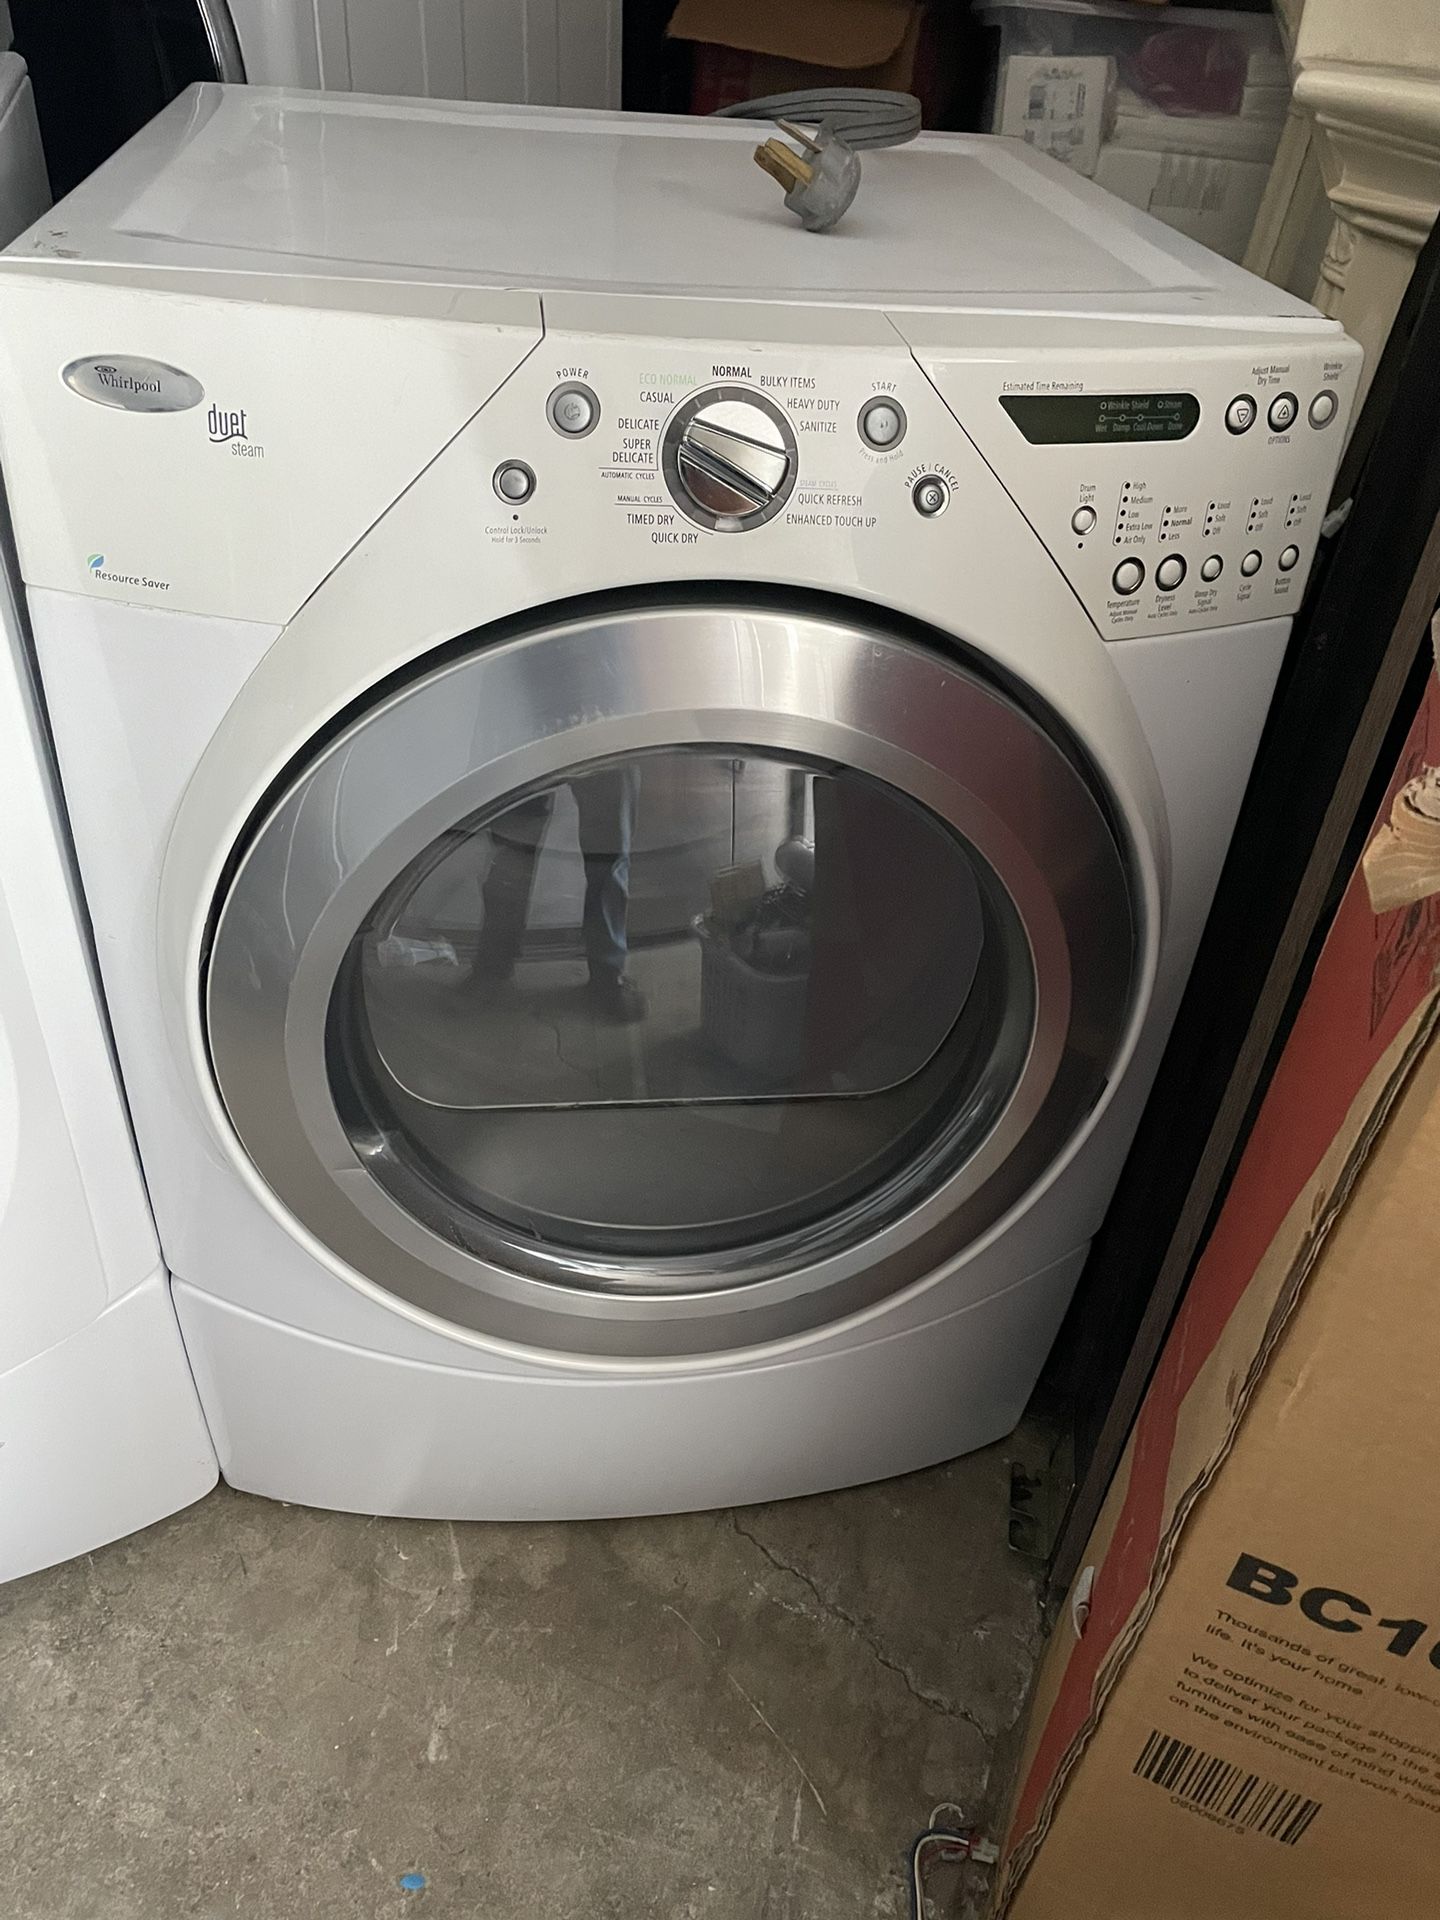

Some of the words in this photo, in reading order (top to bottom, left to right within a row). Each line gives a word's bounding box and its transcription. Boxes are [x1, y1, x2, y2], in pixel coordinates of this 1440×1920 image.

[556, 367, 589, 380] POWER
[712, 366, 752, 378] NORMAL
[1270, 365, 1290, 374] Manual
[98, 373, 161, 394] Whirlpool
[640, 373, 657, 385] ECO
[660, 374, 698, 386] NORMAL
[760, 375, 788, 388] BULKY
[790, 377, 816, 389] ITEMS
[871, 381, 897, 393] START
[1003, 381, 1035, 391] Estimated
[1036, 381, 1050, 390] Time
[1052, 381, 1084, 392] Remaining
[640, 391, 675, 404] CASUAL
[787, 398, 815, 410] HEAVY
[817, 399, 840, 411] DUTY
[207, 403, 248, 439] duet
[618, 418, 660, 430] DELICATE
[799, 420, 837, 433] SANITIZE
[623, 437, 651, 450] SUPER
[232, 442, 265, 459] steam
[612, 451, 654, 464] DELICATE
[600, 471, 633, 480] AUTOMATIC
[904, 463, 926, 489] PAUSE
[934, 463, 960, 492] CANCEL
[1080, 484, 1097, 492] Drum
[1132, 481, 1147, 491] High
[617, 495, 641, 503] MANUAL
[798, 493, 825, 506] QUICK
[826, 494, 863, 507] REFRESH
[1079, 494, 1095, 504] Light
[1130, 496, 1153, 504] Medium
[627, 513, 655, 526] TIMED
[657, 514, 675, 526] DRY
[786, 513, 833, 526] ENHANCED
[834, 515, 863, 528] TOUCH
[865, 516, 877, 528] UP
[1127, 511, 1140, 519] Low
[1125, 523, 1141, 532] Extra
[1141, 522, 1153, 531] Low
[1171, 517, 1193, 527] Normal
[484, 526, 510, 535] Control
[511, 526, 547, 535] Lock/Unlock
[651, 531, 680, 545] QUICK
[681, 533, 699, 544] DRY
[95, 569, 140, 586] Resource
[141, 577, 171, 591] Saver
[1107, 599, 1140, 609] Temperature
[1216, 1609, 1312, 1656] Thousands
[1316, 1653, 1335, 1665] of
[1338, 1663, 1388, 1689] great,
[1241, 1638, 1266, 1656] It's
[1270, 1652, 1312, 1673] your
[1191, 1651, 1219, 1670] We
[1222, 1668, 1294, 1702] optimize
[1298, 1699, 1321, 1714] for
[1324, 1711, 1362, 1731] your
[1183, 1667, 1200, 1680] to
[1202, 1676, 1258, 1705] deliver
[1261, 1702, 1302, 1722] your
[1302, 1720, 1377, 1754] package
[1380, 1751, 1398, 1762] in
[1402, 1758, 1430, 1774] the
[1176, 1680, 1244, 1716] furniture
[1247, 1712, 1282, 1733] with
[1285, 1729, 1327, 1751] ease
[1330, 1749, 1350, 1760] of
[1351, 1756, 1395, 1778] mind
[1169, 1694, 1190, 1709] on
[1194, 1704, 1220, 1721] the
[1223, 1719, 1327, 1769] environment
[1327, 1763, 1357, 1780] but
[1359, 1777, 1400, 1797] work
